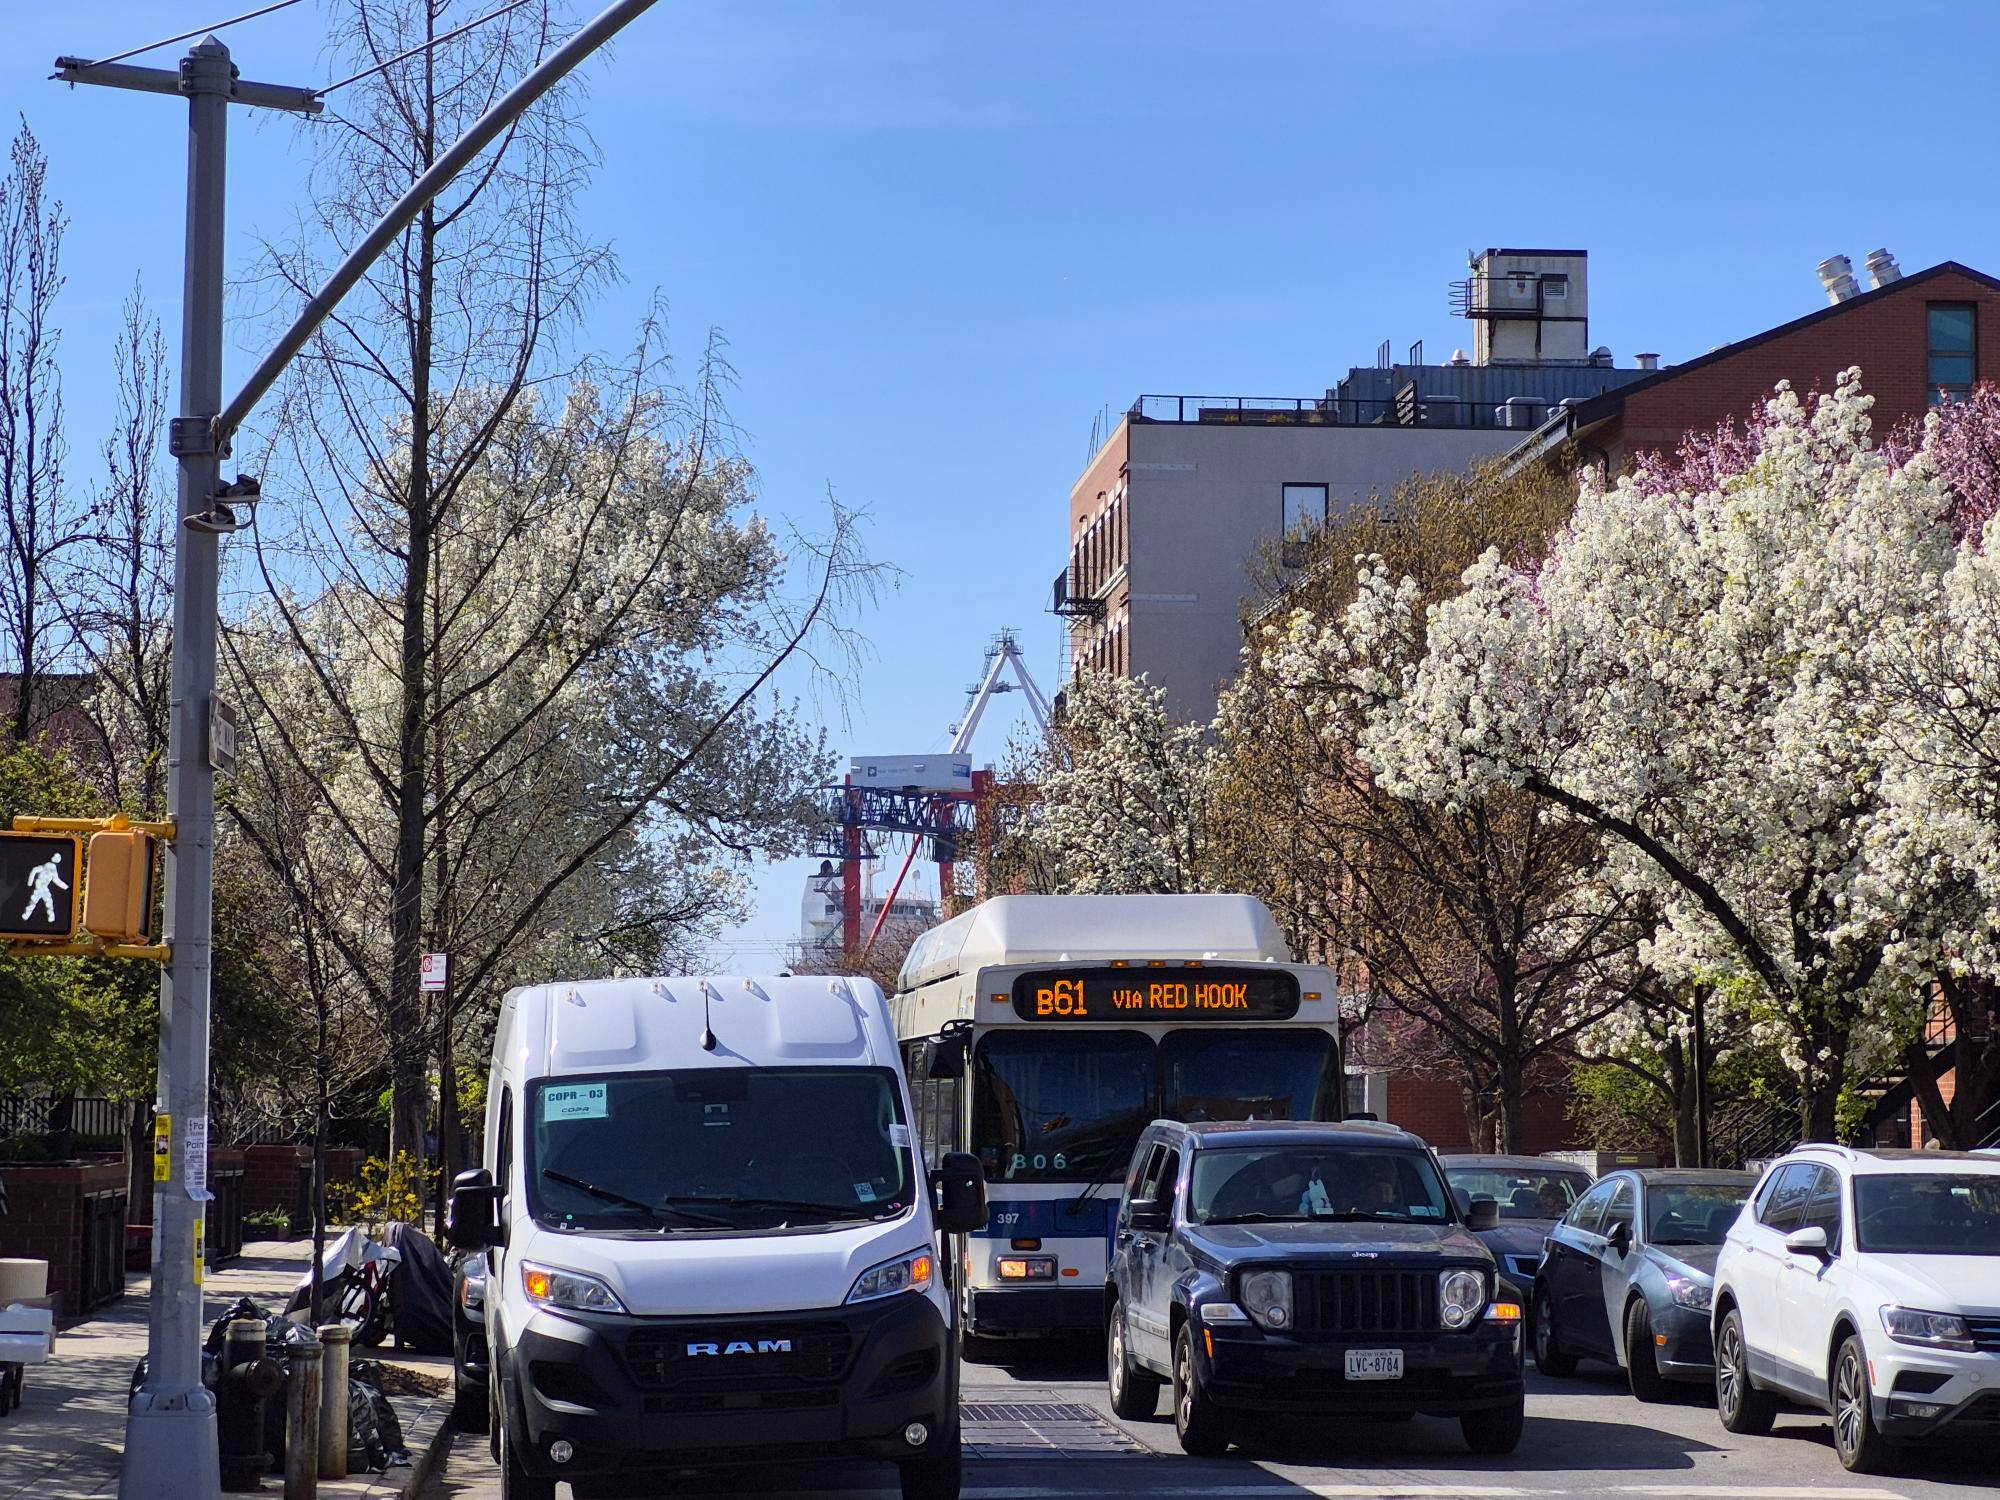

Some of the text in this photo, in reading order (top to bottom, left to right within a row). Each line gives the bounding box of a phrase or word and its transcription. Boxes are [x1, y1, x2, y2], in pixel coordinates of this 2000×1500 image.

[1037, 980, 1248, 1015] B61 VIA RED HOOK
[548, 1091, 577, 1102] COPR
[589, 1089, 604, 1099] 03
[997, 1212, 1020, 1224] 397
[1351, 1251, 1379, 1259] Jeep
[686, 1339, 792, 1357] RAM
